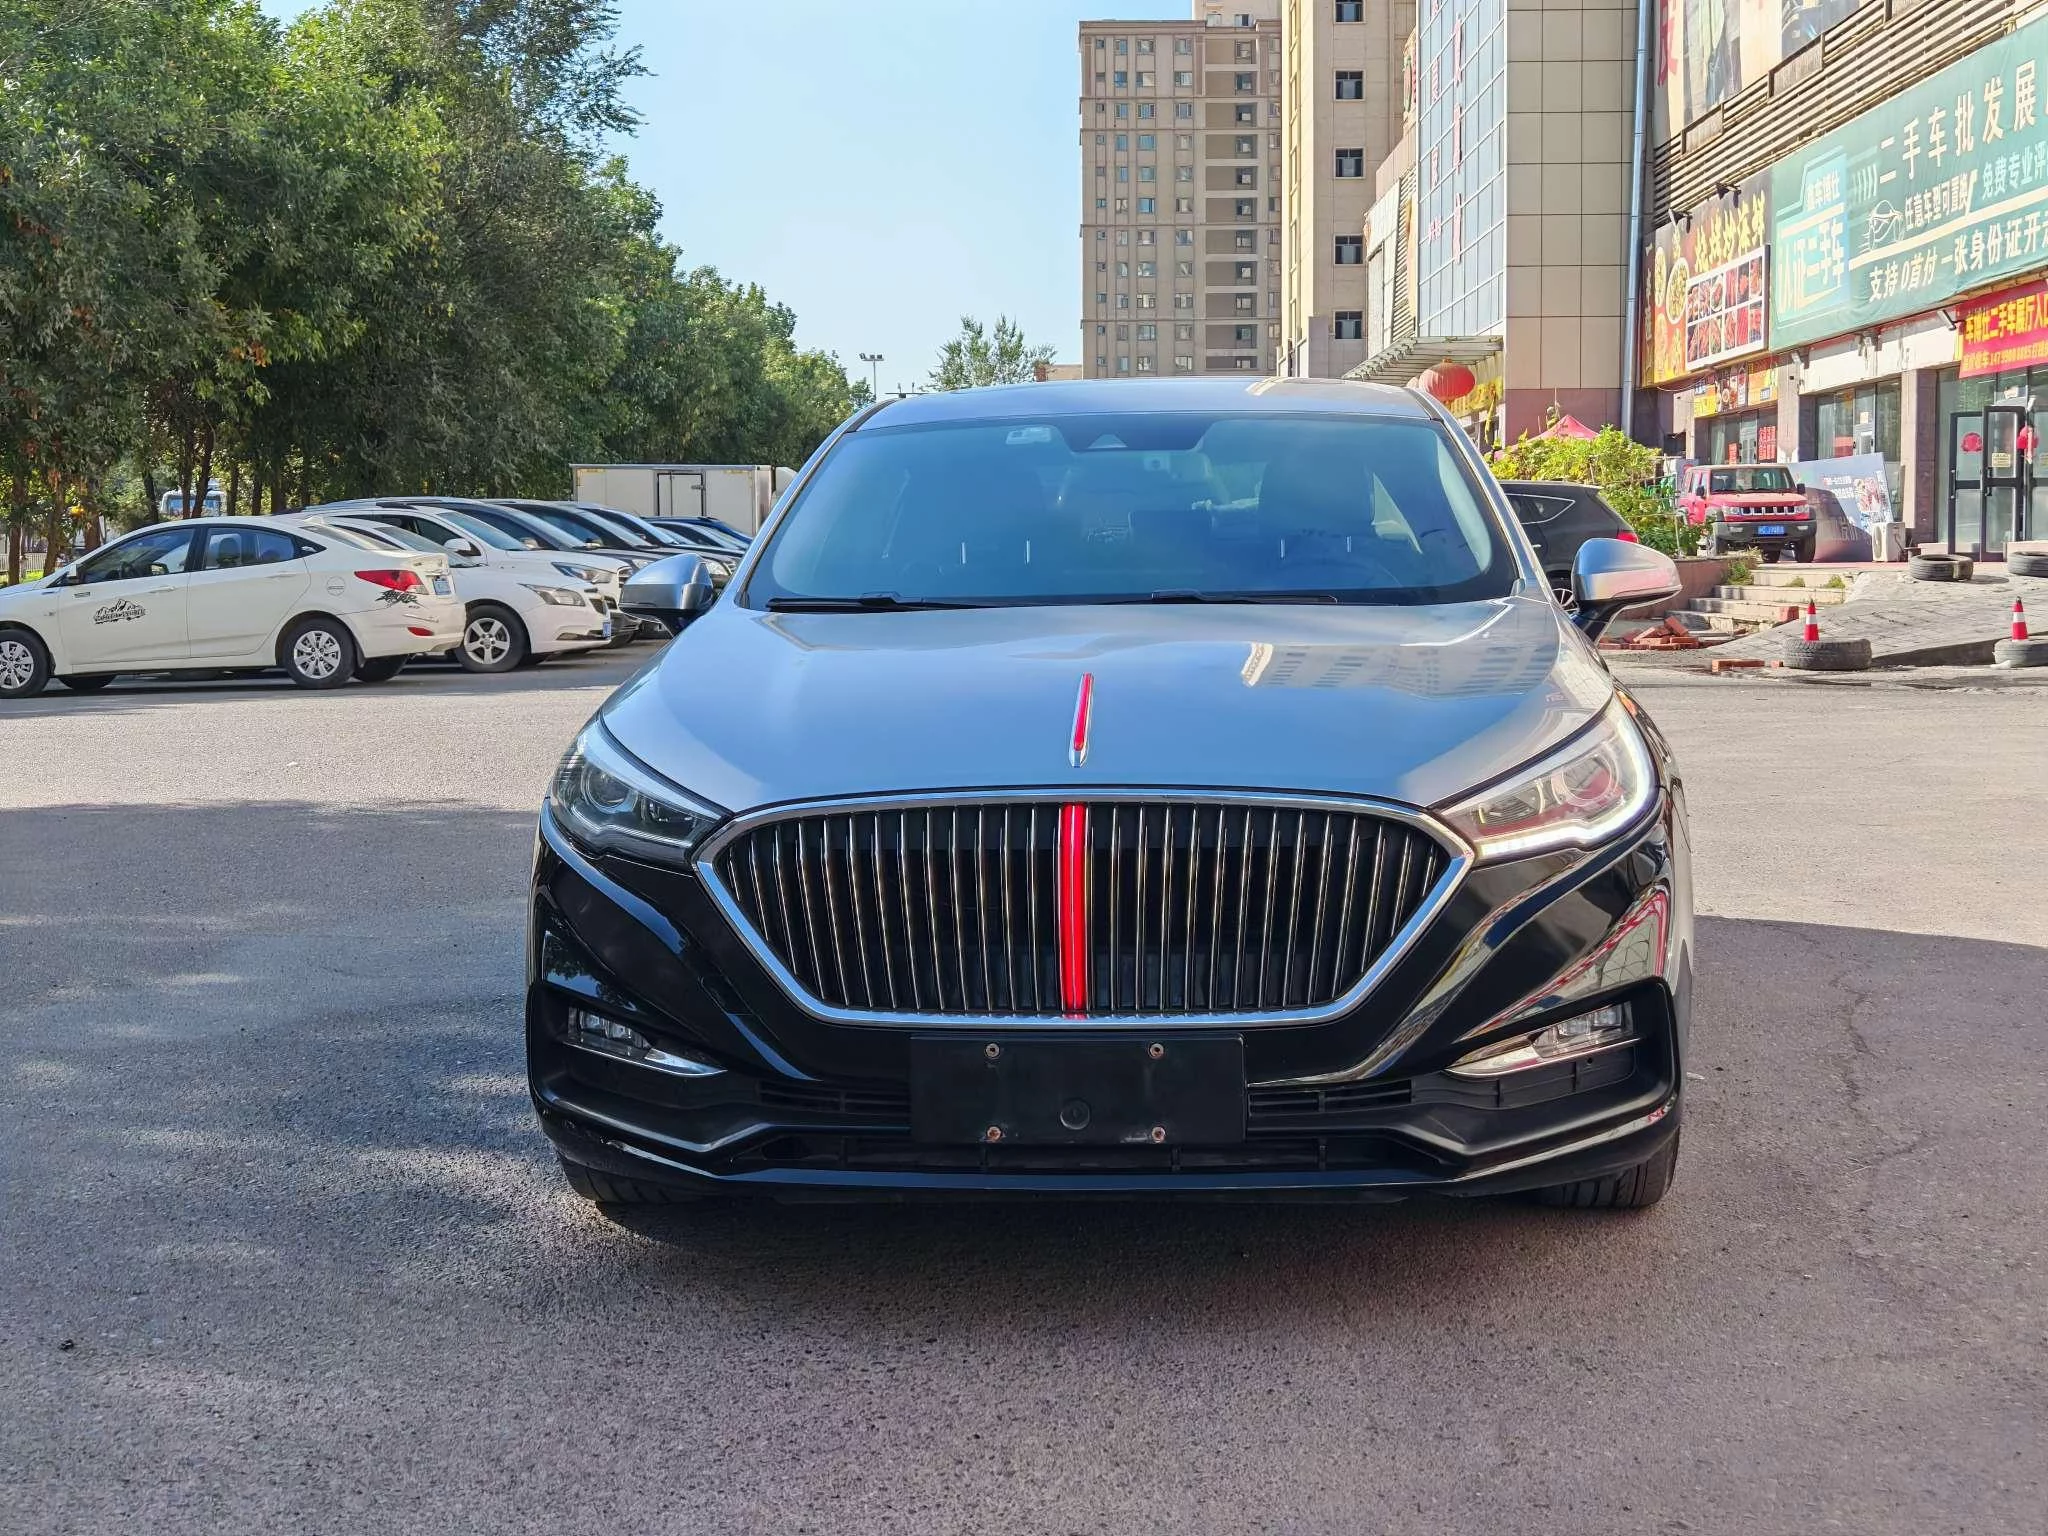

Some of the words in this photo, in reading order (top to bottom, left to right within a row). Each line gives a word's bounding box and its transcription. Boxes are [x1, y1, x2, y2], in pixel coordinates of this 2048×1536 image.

[1879, 59, 2048, 184] 二手车批发展
